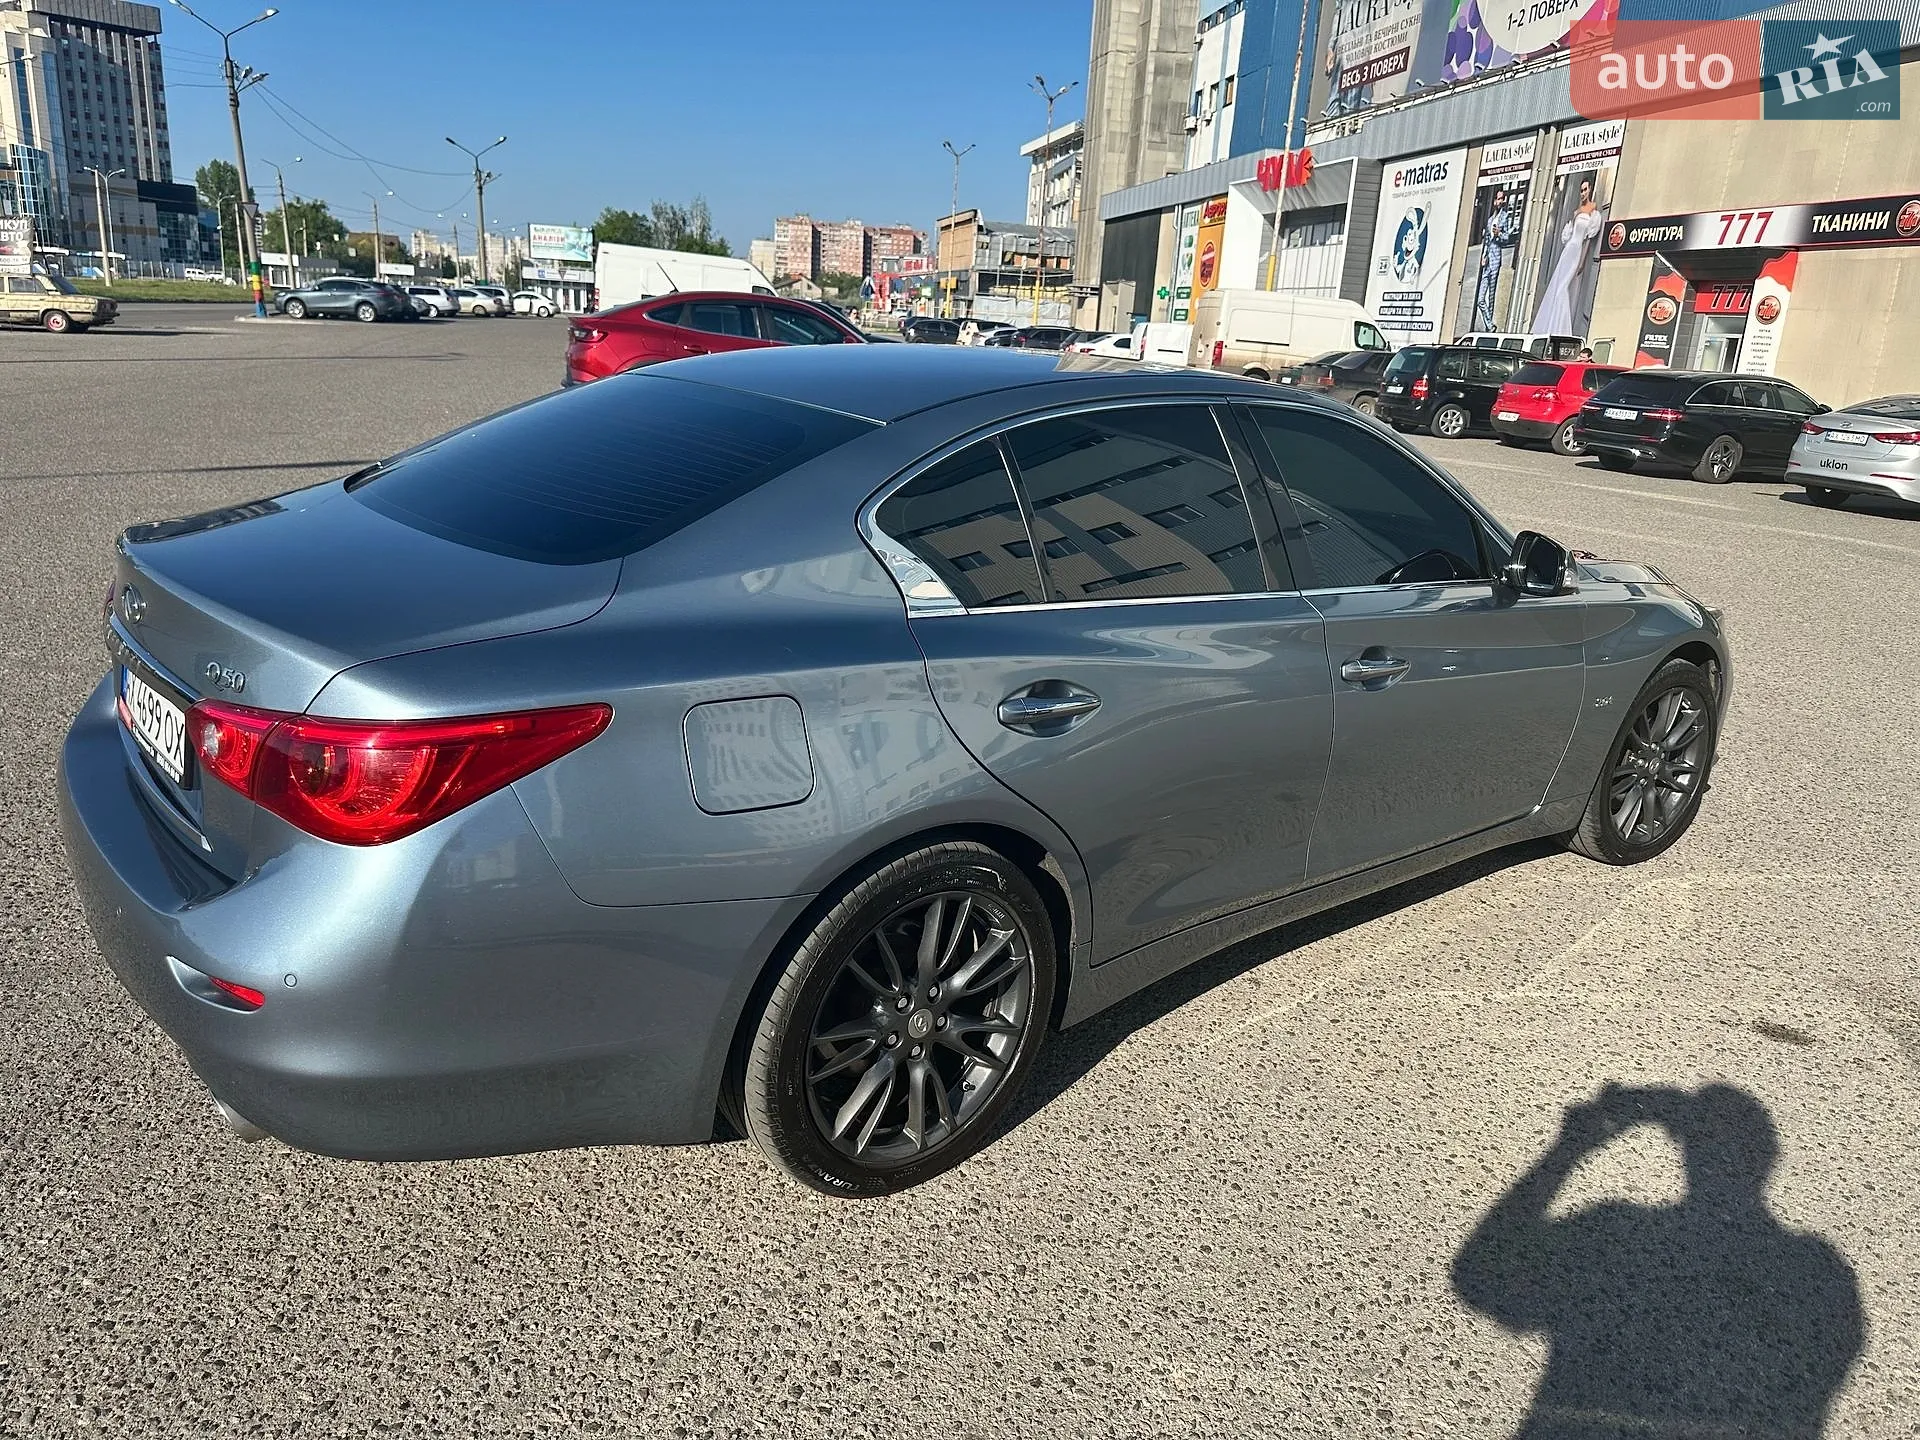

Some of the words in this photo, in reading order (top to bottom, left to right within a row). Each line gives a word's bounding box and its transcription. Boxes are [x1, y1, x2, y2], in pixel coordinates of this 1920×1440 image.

[1507, 9, 1525, 31] 1-2
[1528, 0, 1578, 24] ПОВЕРХ
[1373, 31, 1409, 53] КОСТЮМИ
[1341, 68, 1361, 89] ВЕСЬ
[1361, 65, 1369, 82] 3
[1369, 52, 1406, 79] ПОВЕРХ
[1564, 131, 1596, 150] LAURA
[1485, 147, 1512, 163] LAURA
[1717, 211, 1774, 246] 777
[1811, 210, 1890, 233] ТКАНИНИ
[0, 231, 24, 242] ВТО
[1629, 225, 1684, 243] ФУРНІТУРА
[1711, 284, 1752, 310] 777
[1820, 459, 1848, 470] uklon
[205, 661, 246, 693] Q50
[137, 680, 162, 741] 4699
[164, 709, 185, 769] OX
